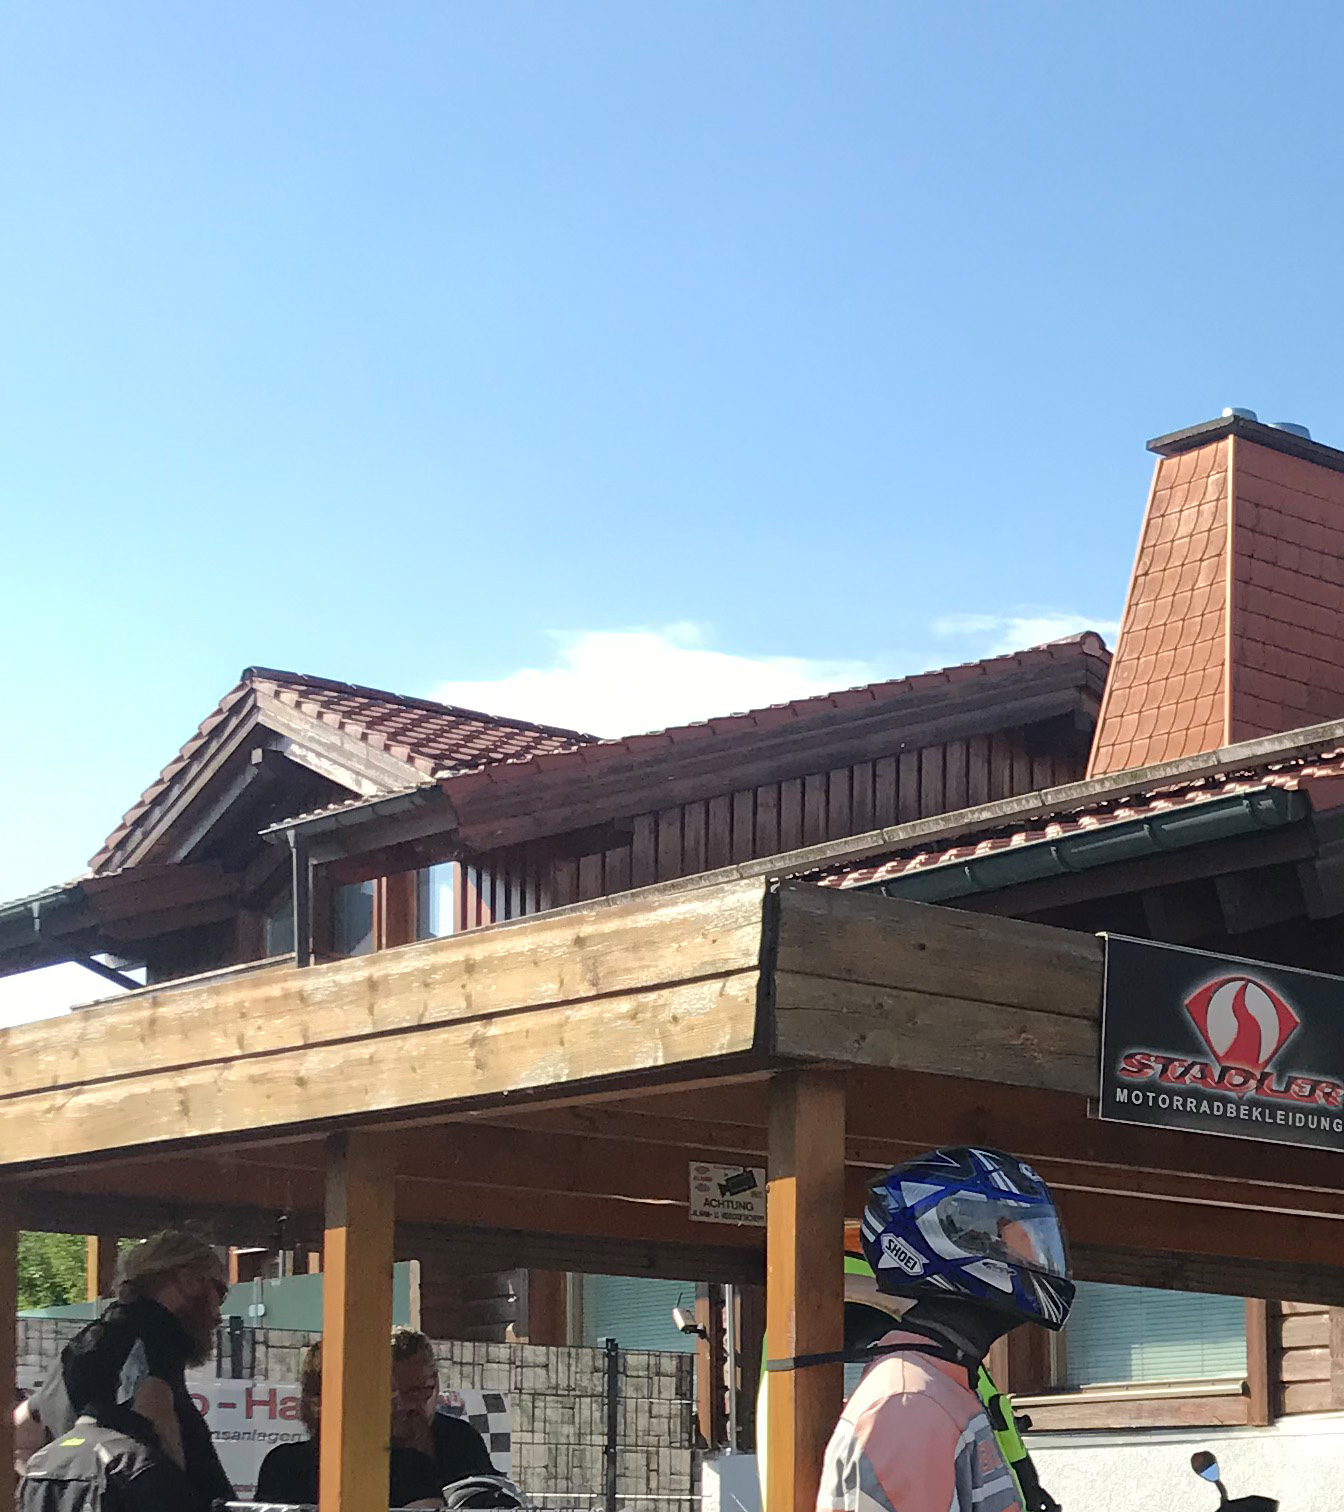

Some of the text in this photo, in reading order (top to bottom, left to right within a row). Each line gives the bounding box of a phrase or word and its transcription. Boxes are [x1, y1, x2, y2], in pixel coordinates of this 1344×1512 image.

[1115, 1087, 1344, 1132] MOTORRADBEKLEIDUNG
[703, 1198, 754, 1212] ACHTUNG
[885, 1238, 918, 1272] SHOEI
